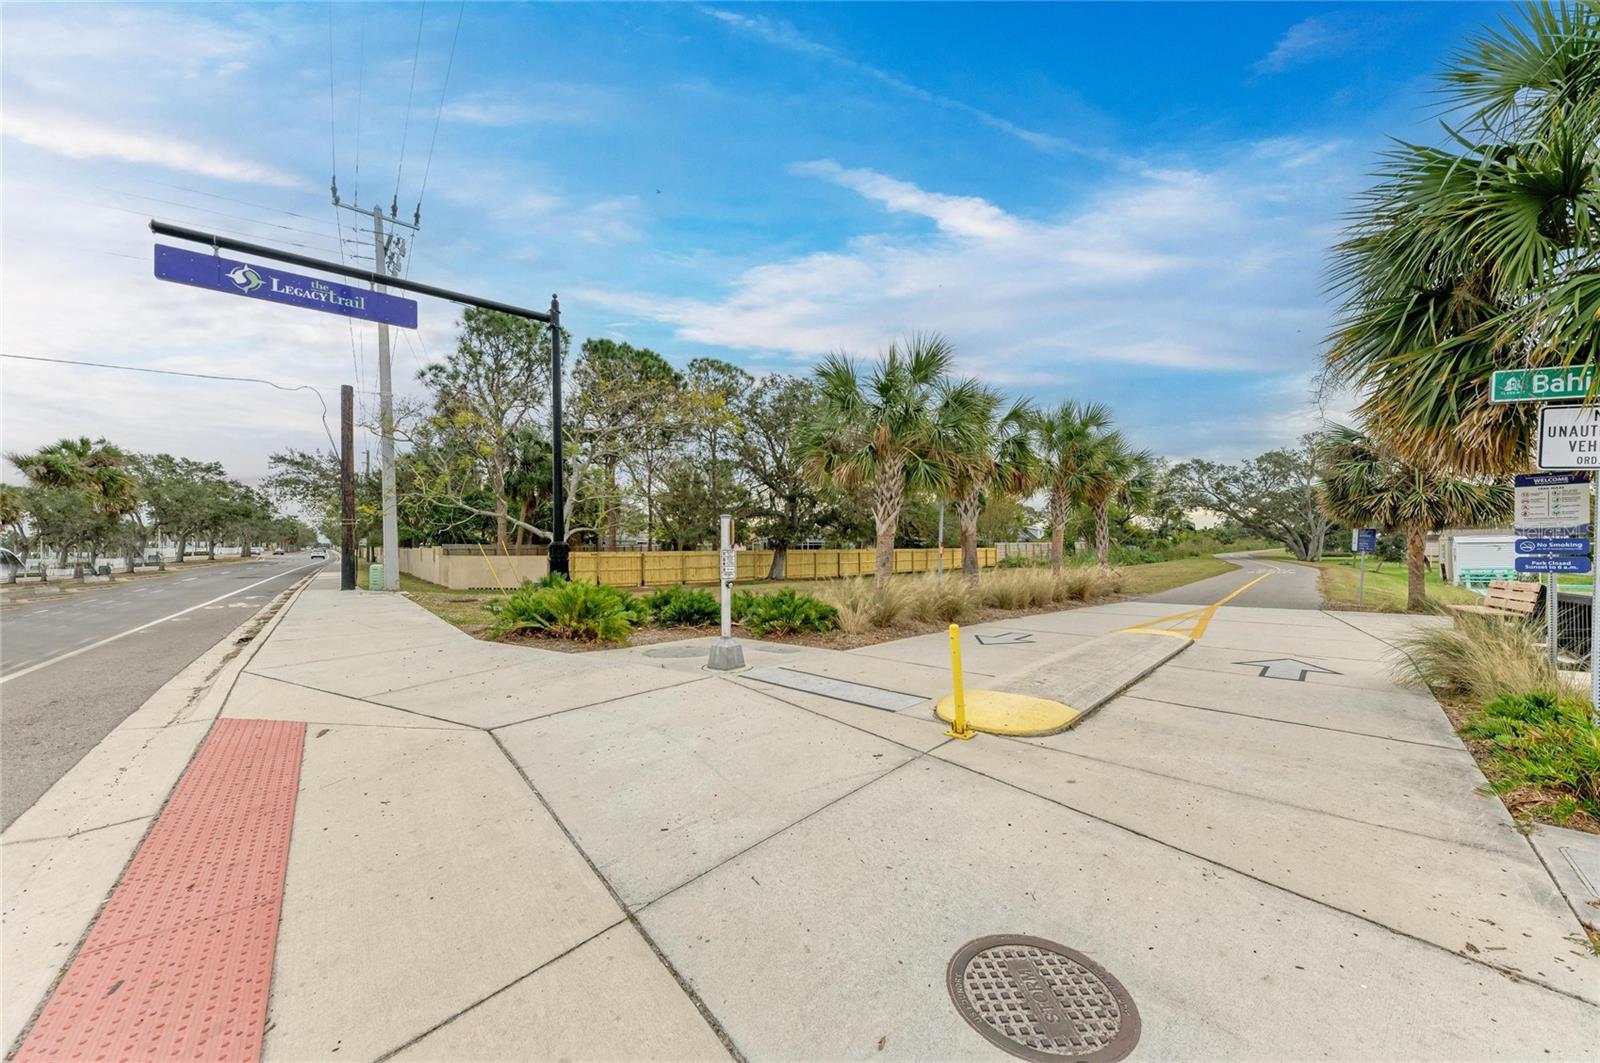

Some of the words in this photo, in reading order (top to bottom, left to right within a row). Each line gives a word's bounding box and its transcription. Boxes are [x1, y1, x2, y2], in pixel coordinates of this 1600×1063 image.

[270, 277, 329, 301] LEGACY
[329, 290, 365, 310] trail
[311, 280, 329, 291] the
[1016, 968, 1061, 1025] STORM
